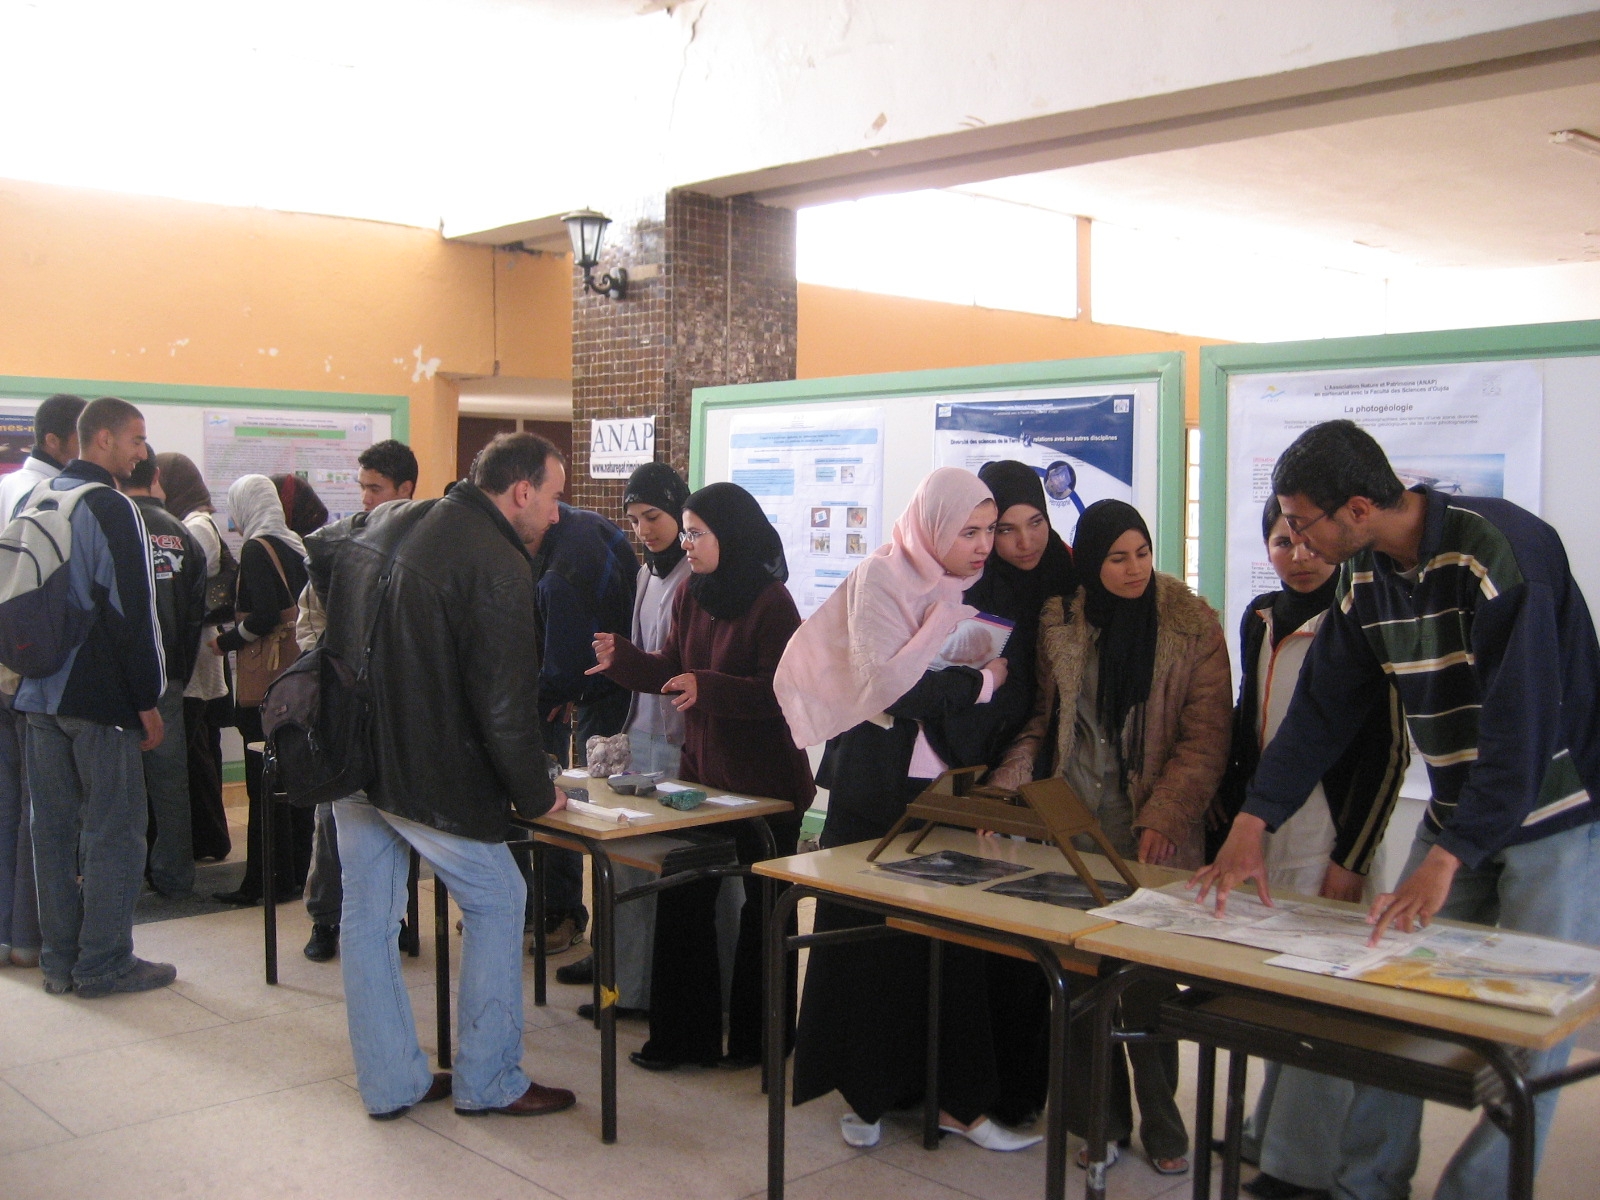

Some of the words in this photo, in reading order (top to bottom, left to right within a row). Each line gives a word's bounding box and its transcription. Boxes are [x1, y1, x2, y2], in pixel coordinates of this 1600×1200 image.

[1344, 405, 1354, 413] La
[1355, 403, 1413, 414] photogéologie
[592, 423, 653, 452] ANAP
